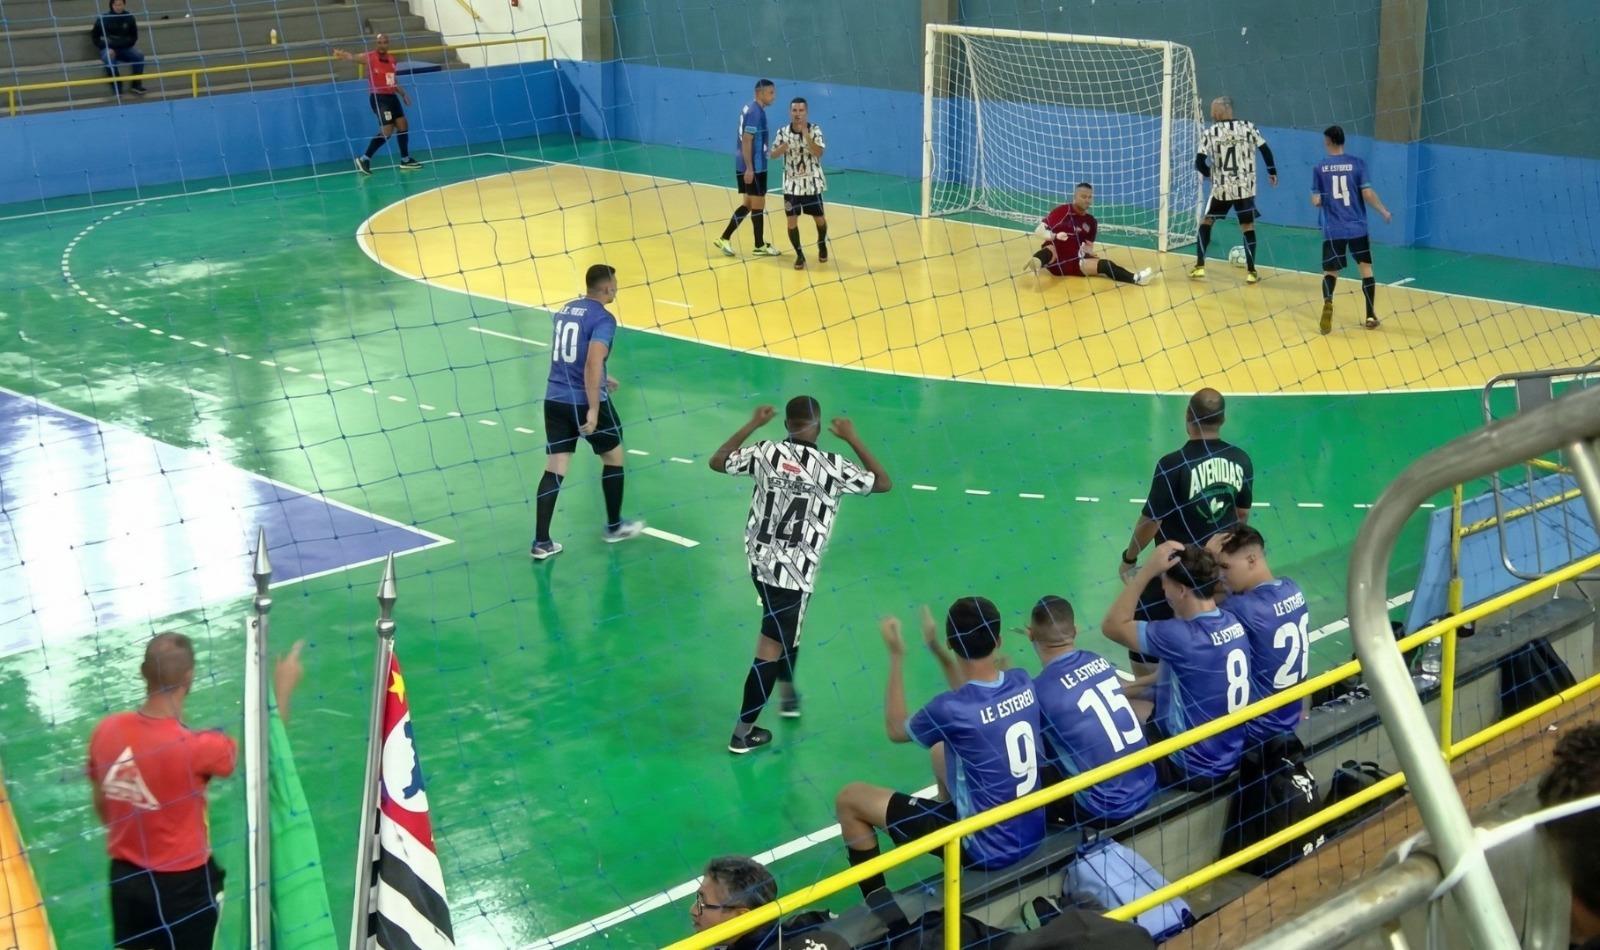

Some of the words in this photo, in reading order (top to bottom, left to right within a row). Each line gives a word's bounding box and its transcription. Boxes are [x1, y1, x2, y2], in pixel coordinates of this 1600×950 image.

[1223, 144, 1239, 177] 4
[1332, 175, 1351, 206] 4
[553, 319, 579, 363] 10
[1189, 457, 1244, 500] AVENIDAS
[756, 490, 809, 548] 14
[1226, 648, 1250, 714] 8
[1077, 675, 1144, 753] 15
[1005, 720, 1038, 798] 9
